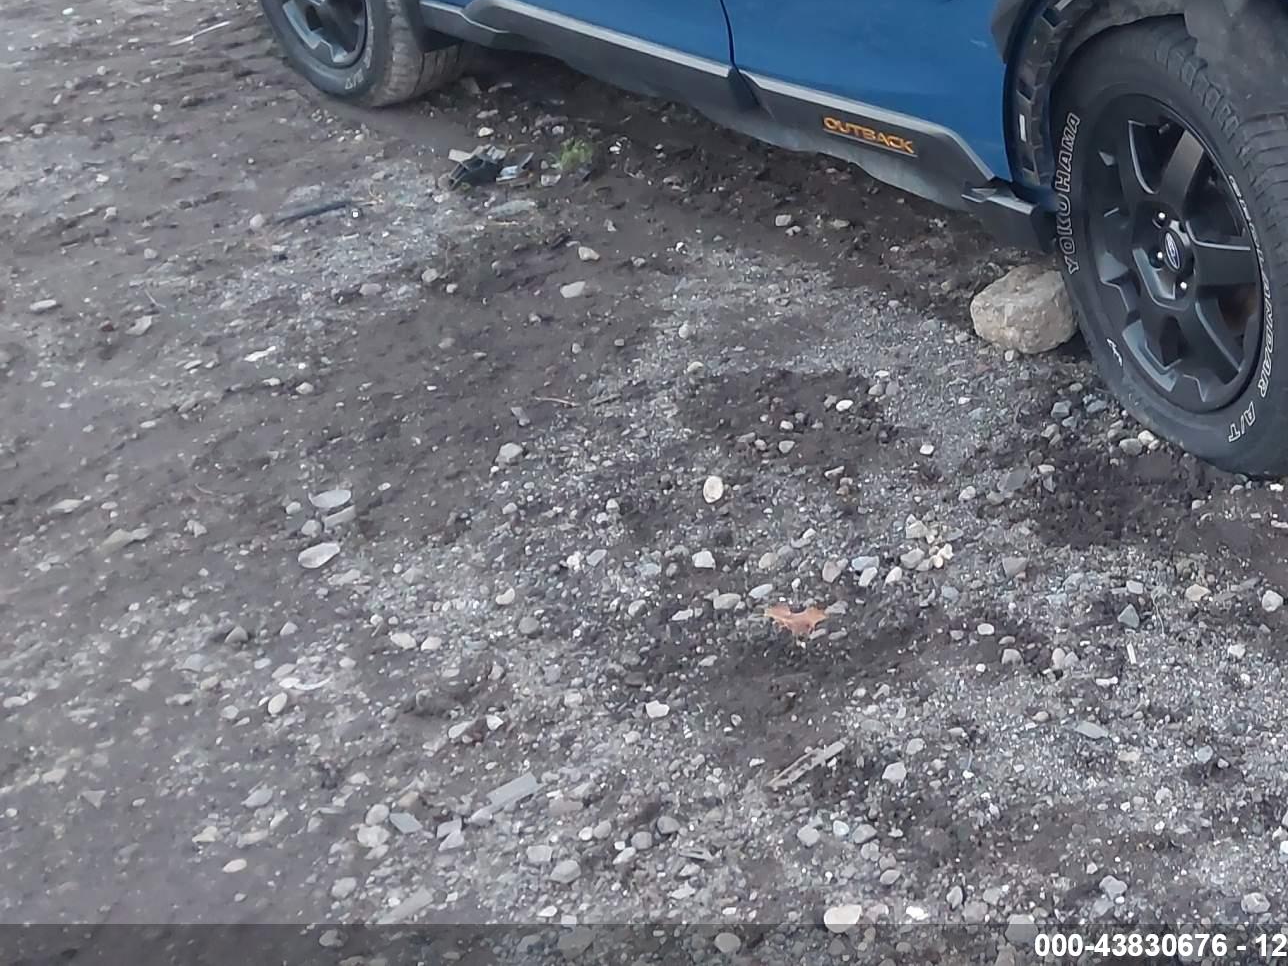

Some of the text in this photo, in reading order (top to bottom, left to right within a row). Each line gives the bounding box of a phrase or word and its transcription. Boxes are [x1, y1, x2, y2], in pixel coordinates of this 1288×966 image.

[822, 116, 916, 155] OUTBACK
[1055, 112, 1081, 275] YOKOHAMA
[1228, 401, 1256, 443] A/T
